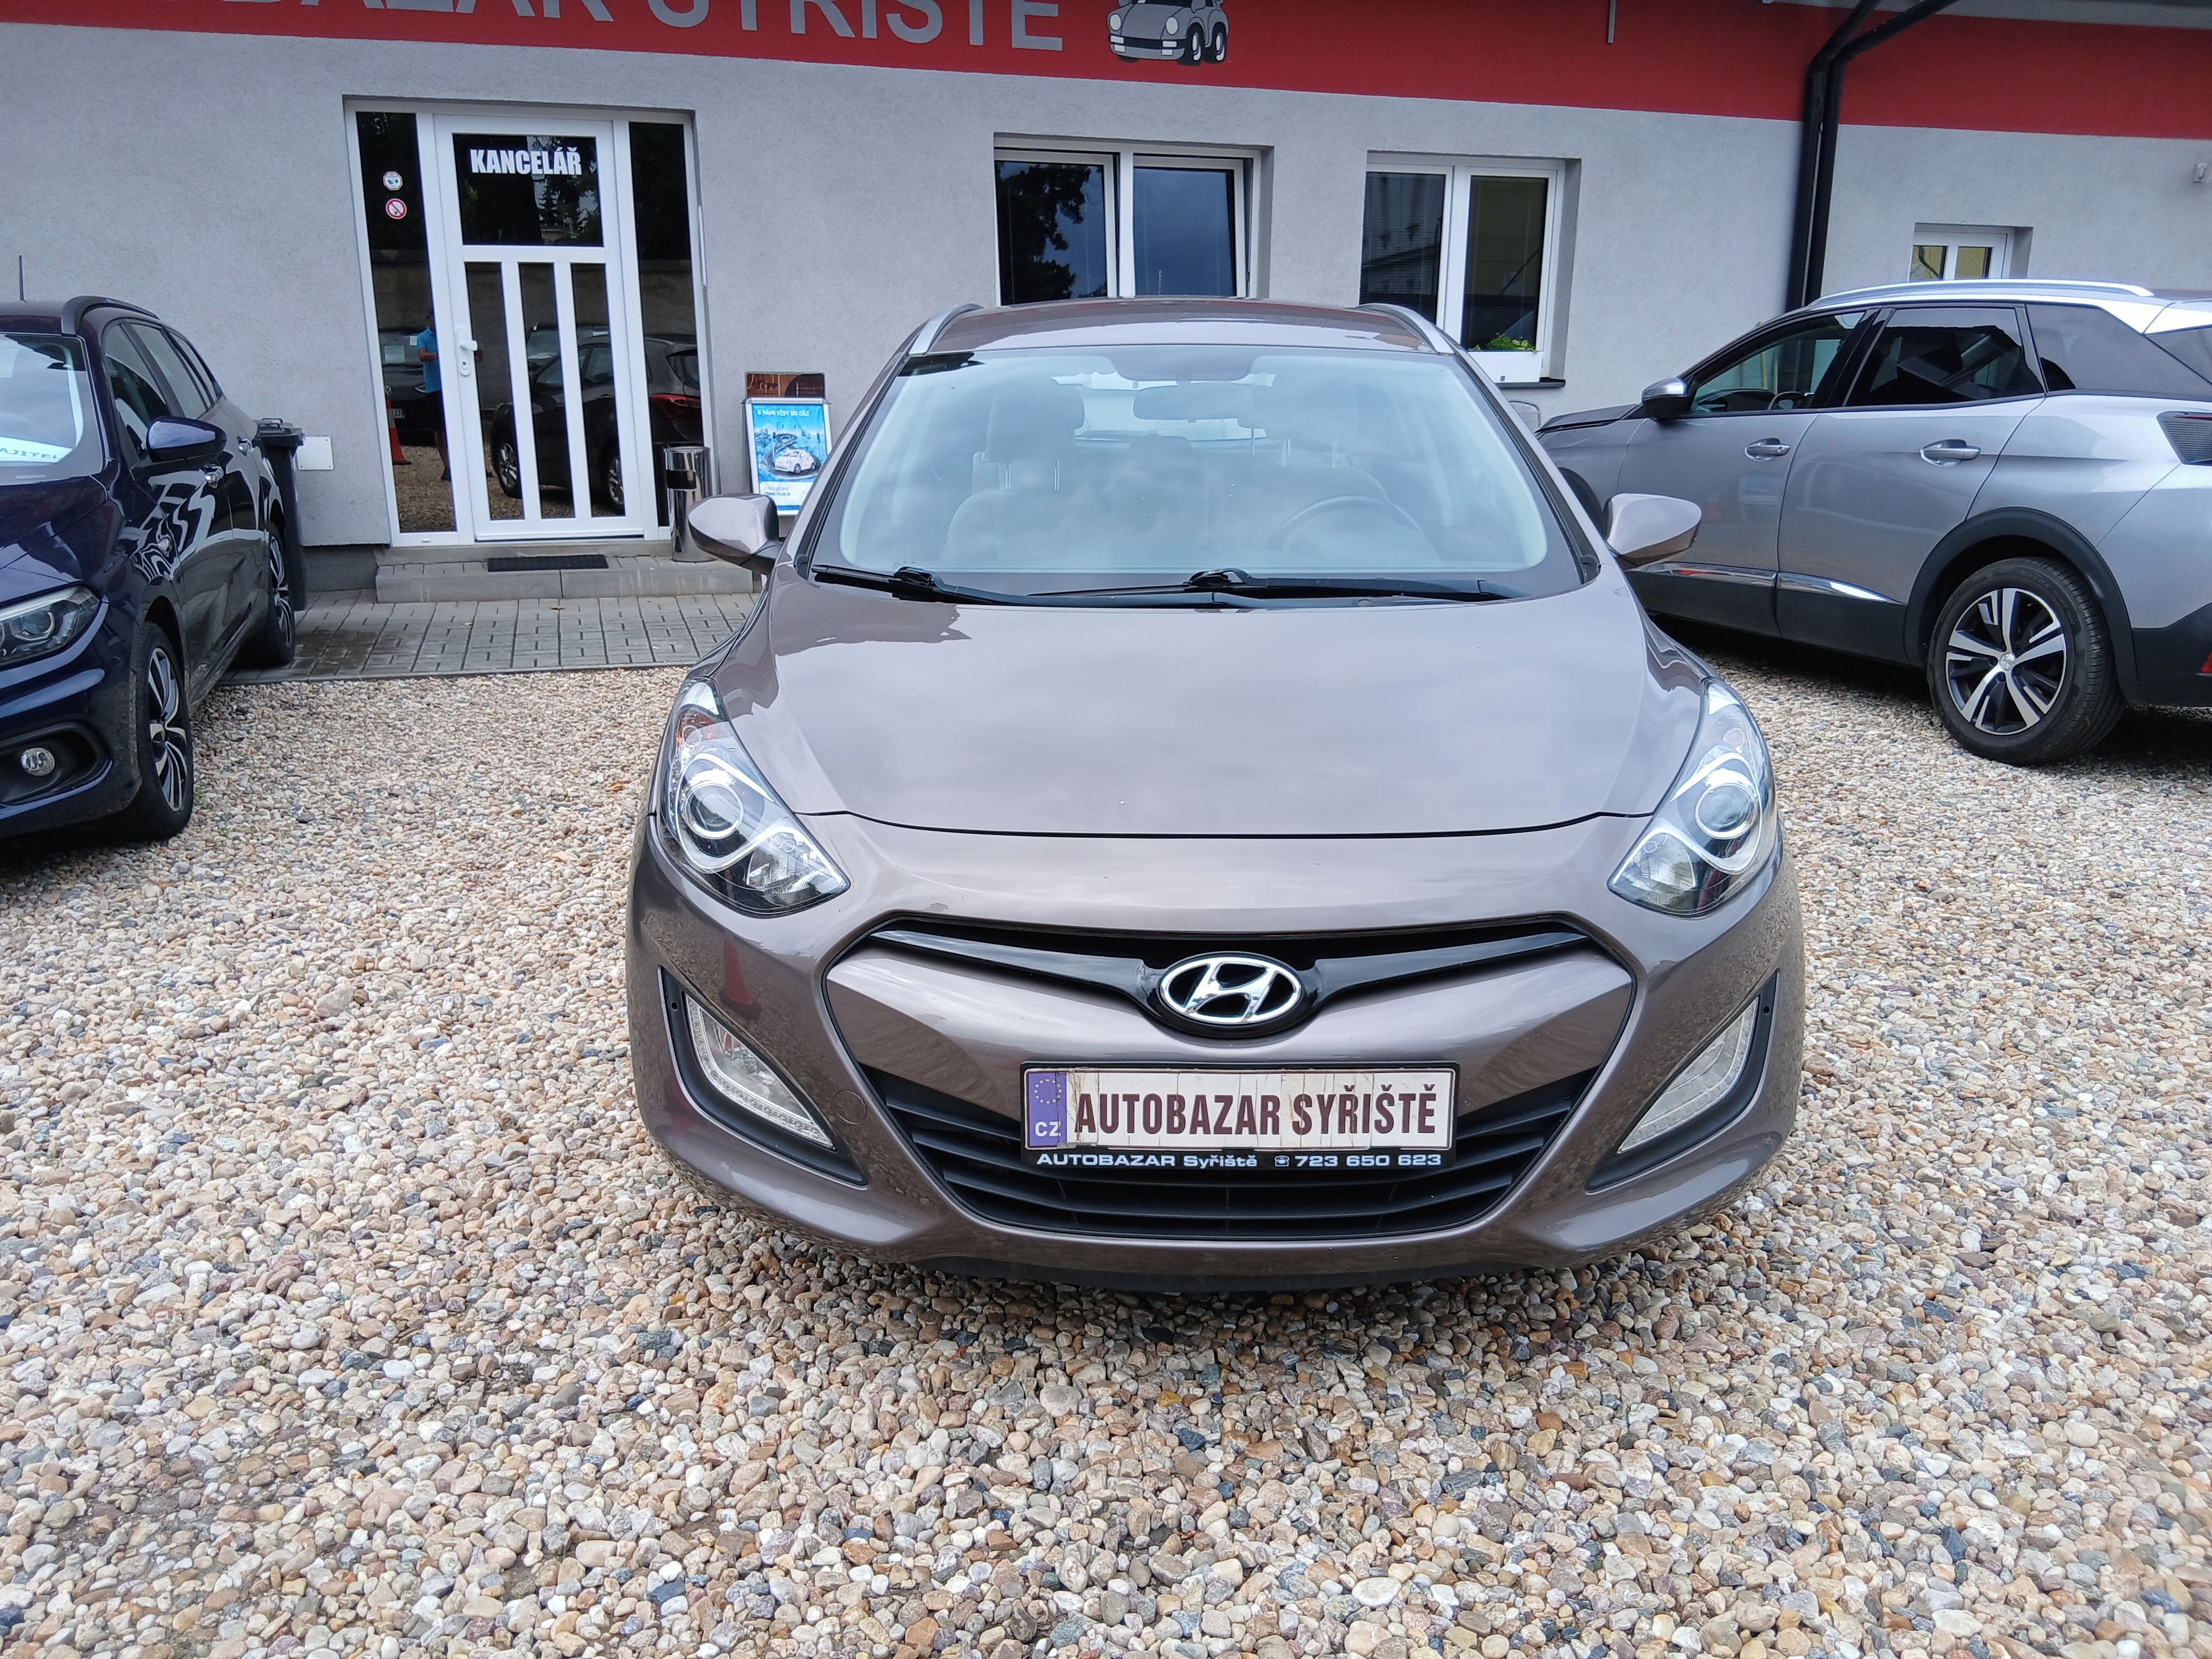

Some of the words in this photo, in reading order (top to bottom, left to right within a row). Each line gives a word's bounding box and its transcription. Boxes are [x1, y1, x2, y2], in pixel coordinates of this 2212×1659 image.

[470, 146, 582, 175] KANCELÁŘ
[1075, 1093, 1280, 1134] AUTOBAZAR
[1292, 1084, 1436, 1135] SYŘIŠTĚ
[1034, 1121, 1061, 1137] CZ
[1037, 1153, 1175, 1167] AUTOBAZAR
[1184, 1154, 1257, 1169] Syřiště
[1295, 1155, 1338, 1167] 723
[1346, 1155, 1390, 1167] 650
[1398, 1154, 1442, 1166] 623
